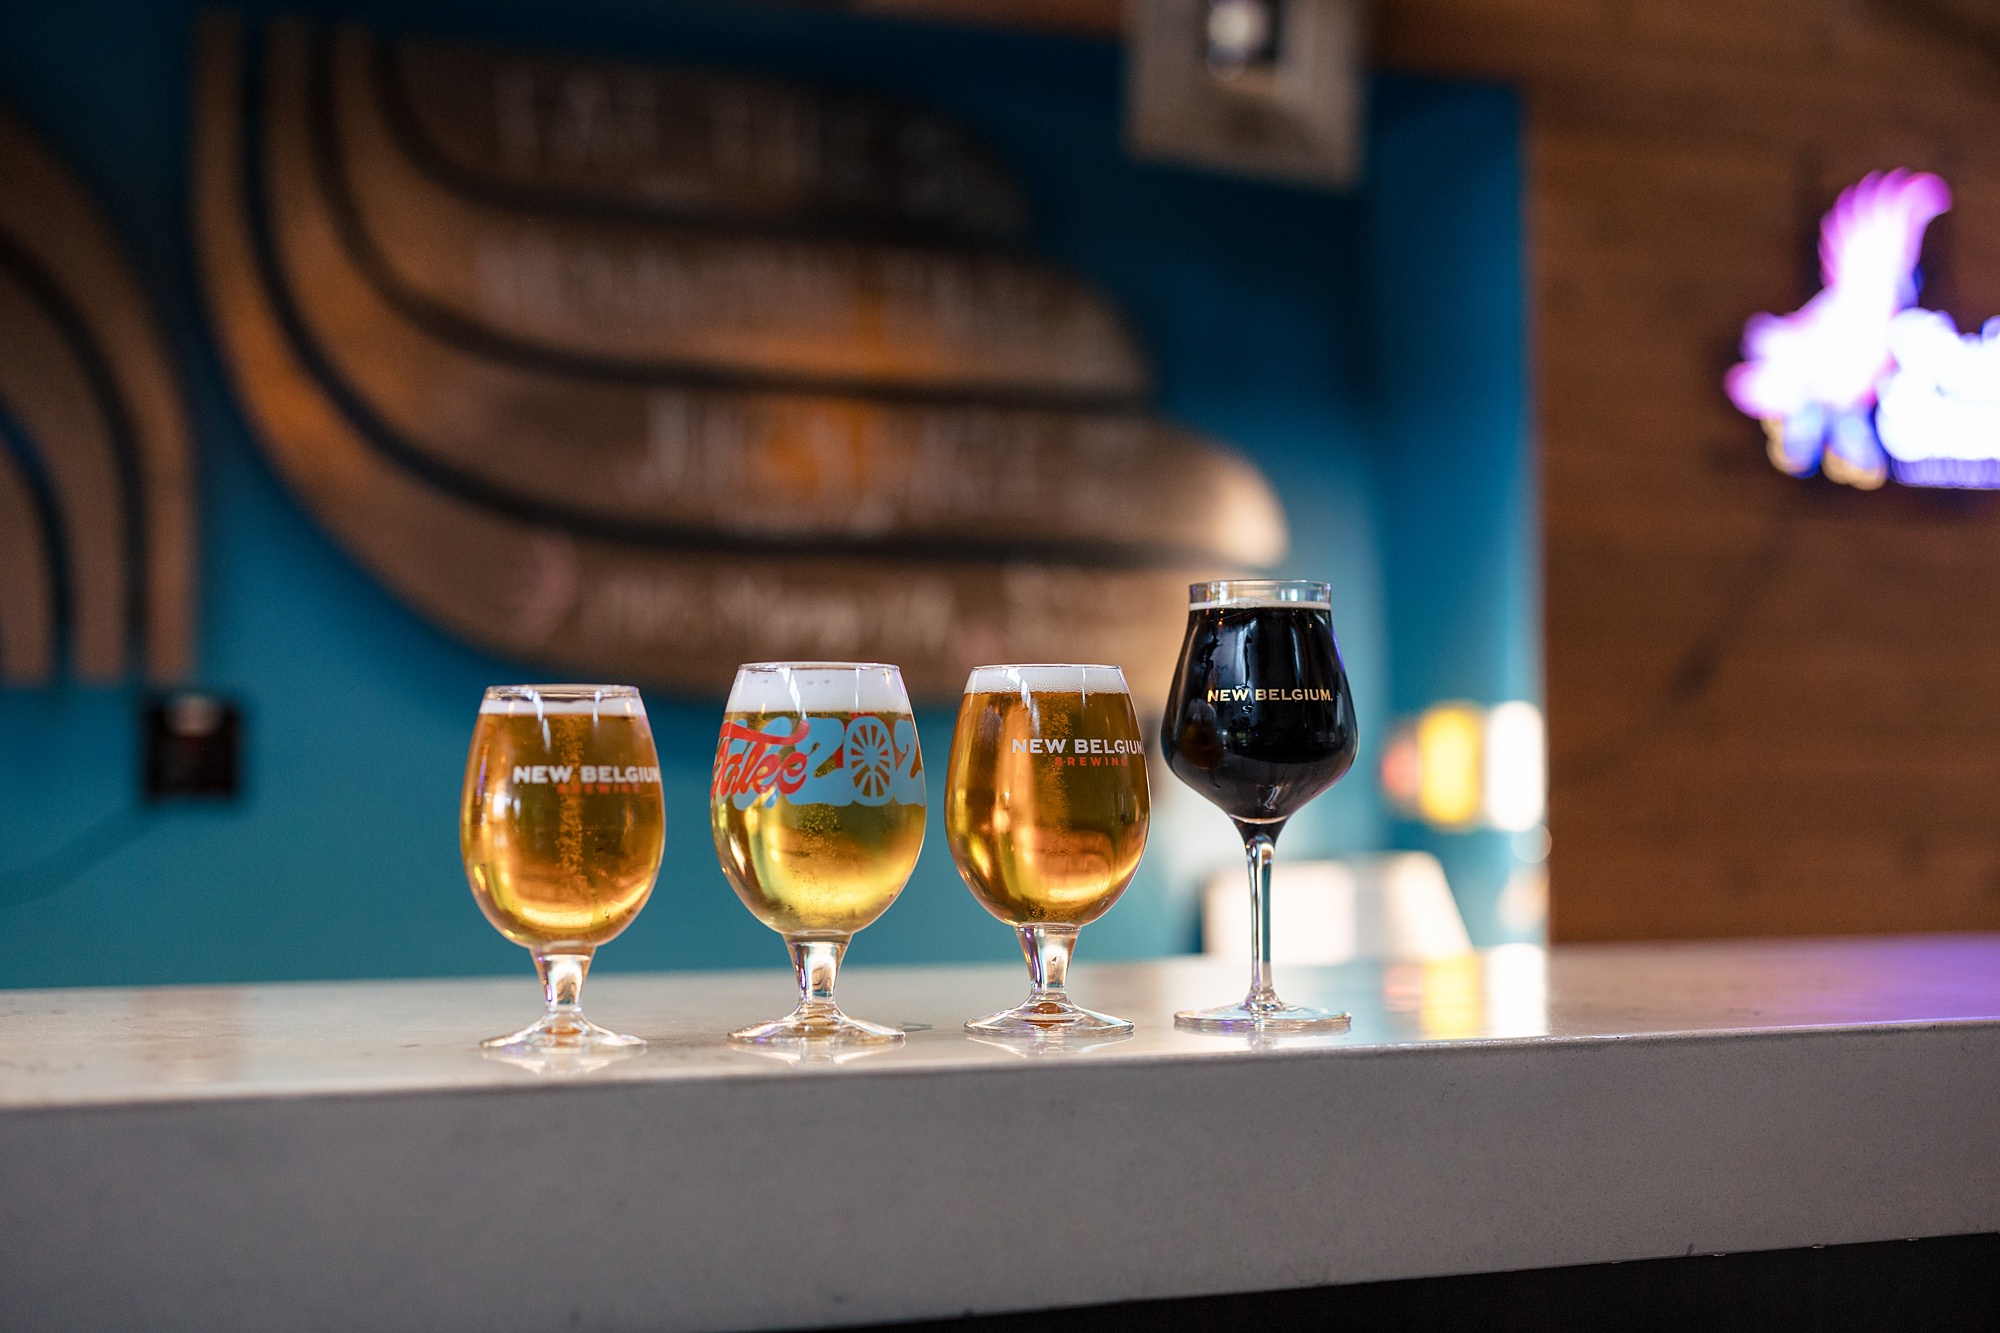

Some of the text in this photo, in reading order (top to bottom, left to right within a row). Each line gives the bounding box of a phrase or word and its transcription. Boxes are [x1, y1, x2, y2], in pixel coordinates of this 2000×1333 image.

[1207, 689, 1249, 703] NEW
[1012, 738, 1067, 754] NEW
[1055, 756, 1129, 767] BREWING
[513, 765, 573, 784] NEW
